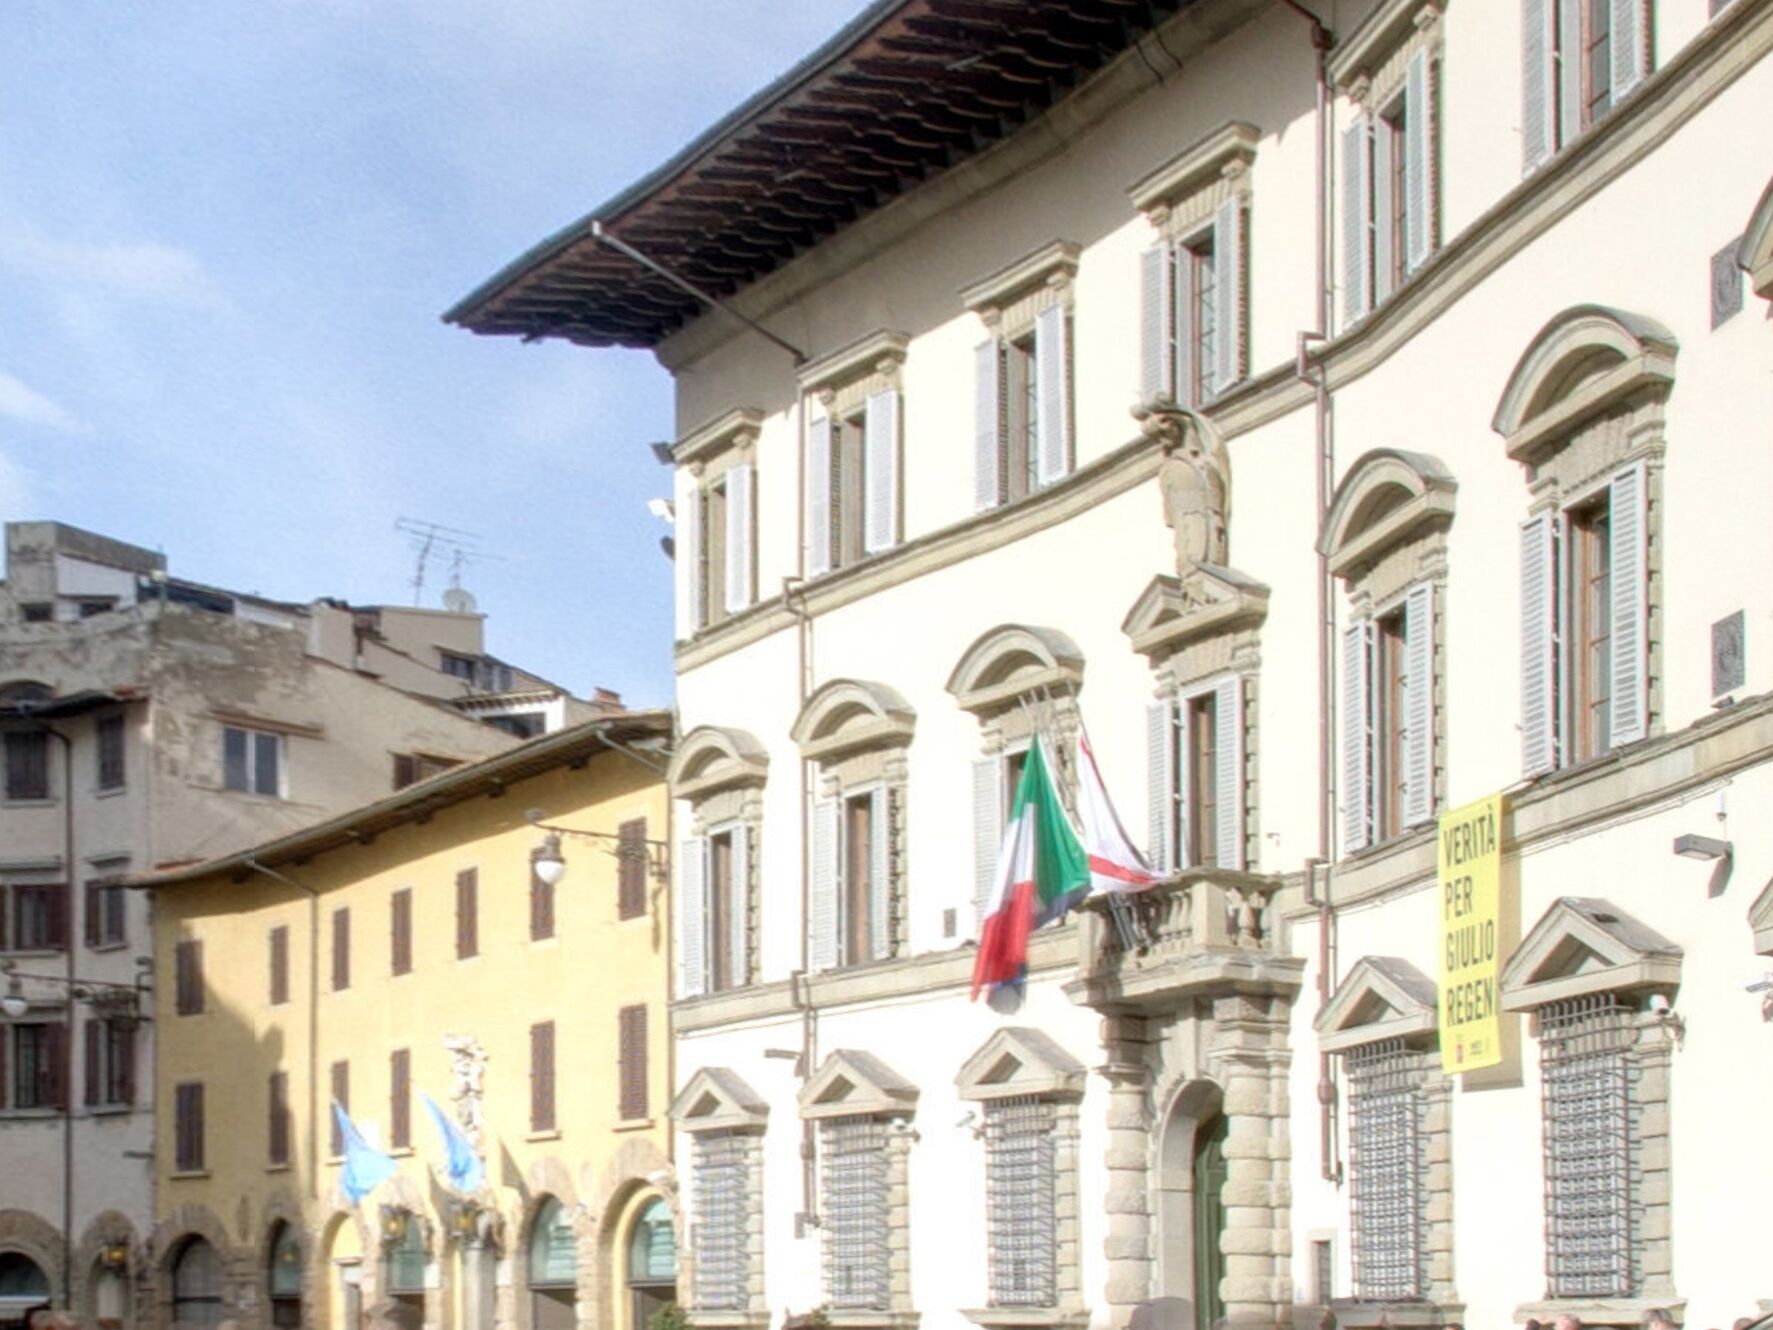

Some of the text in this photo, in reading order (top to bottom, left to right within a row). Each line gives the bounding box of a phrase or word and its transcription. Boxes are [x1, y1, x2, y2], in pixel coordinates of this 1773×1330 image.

[1443, 804, 1496, 867] VERITÀ
[1445, 875, 1473, 922] PER
[1446, 919, 1495, 973] GIULIO
[1446, 976, 1497, 1027] REGEN
